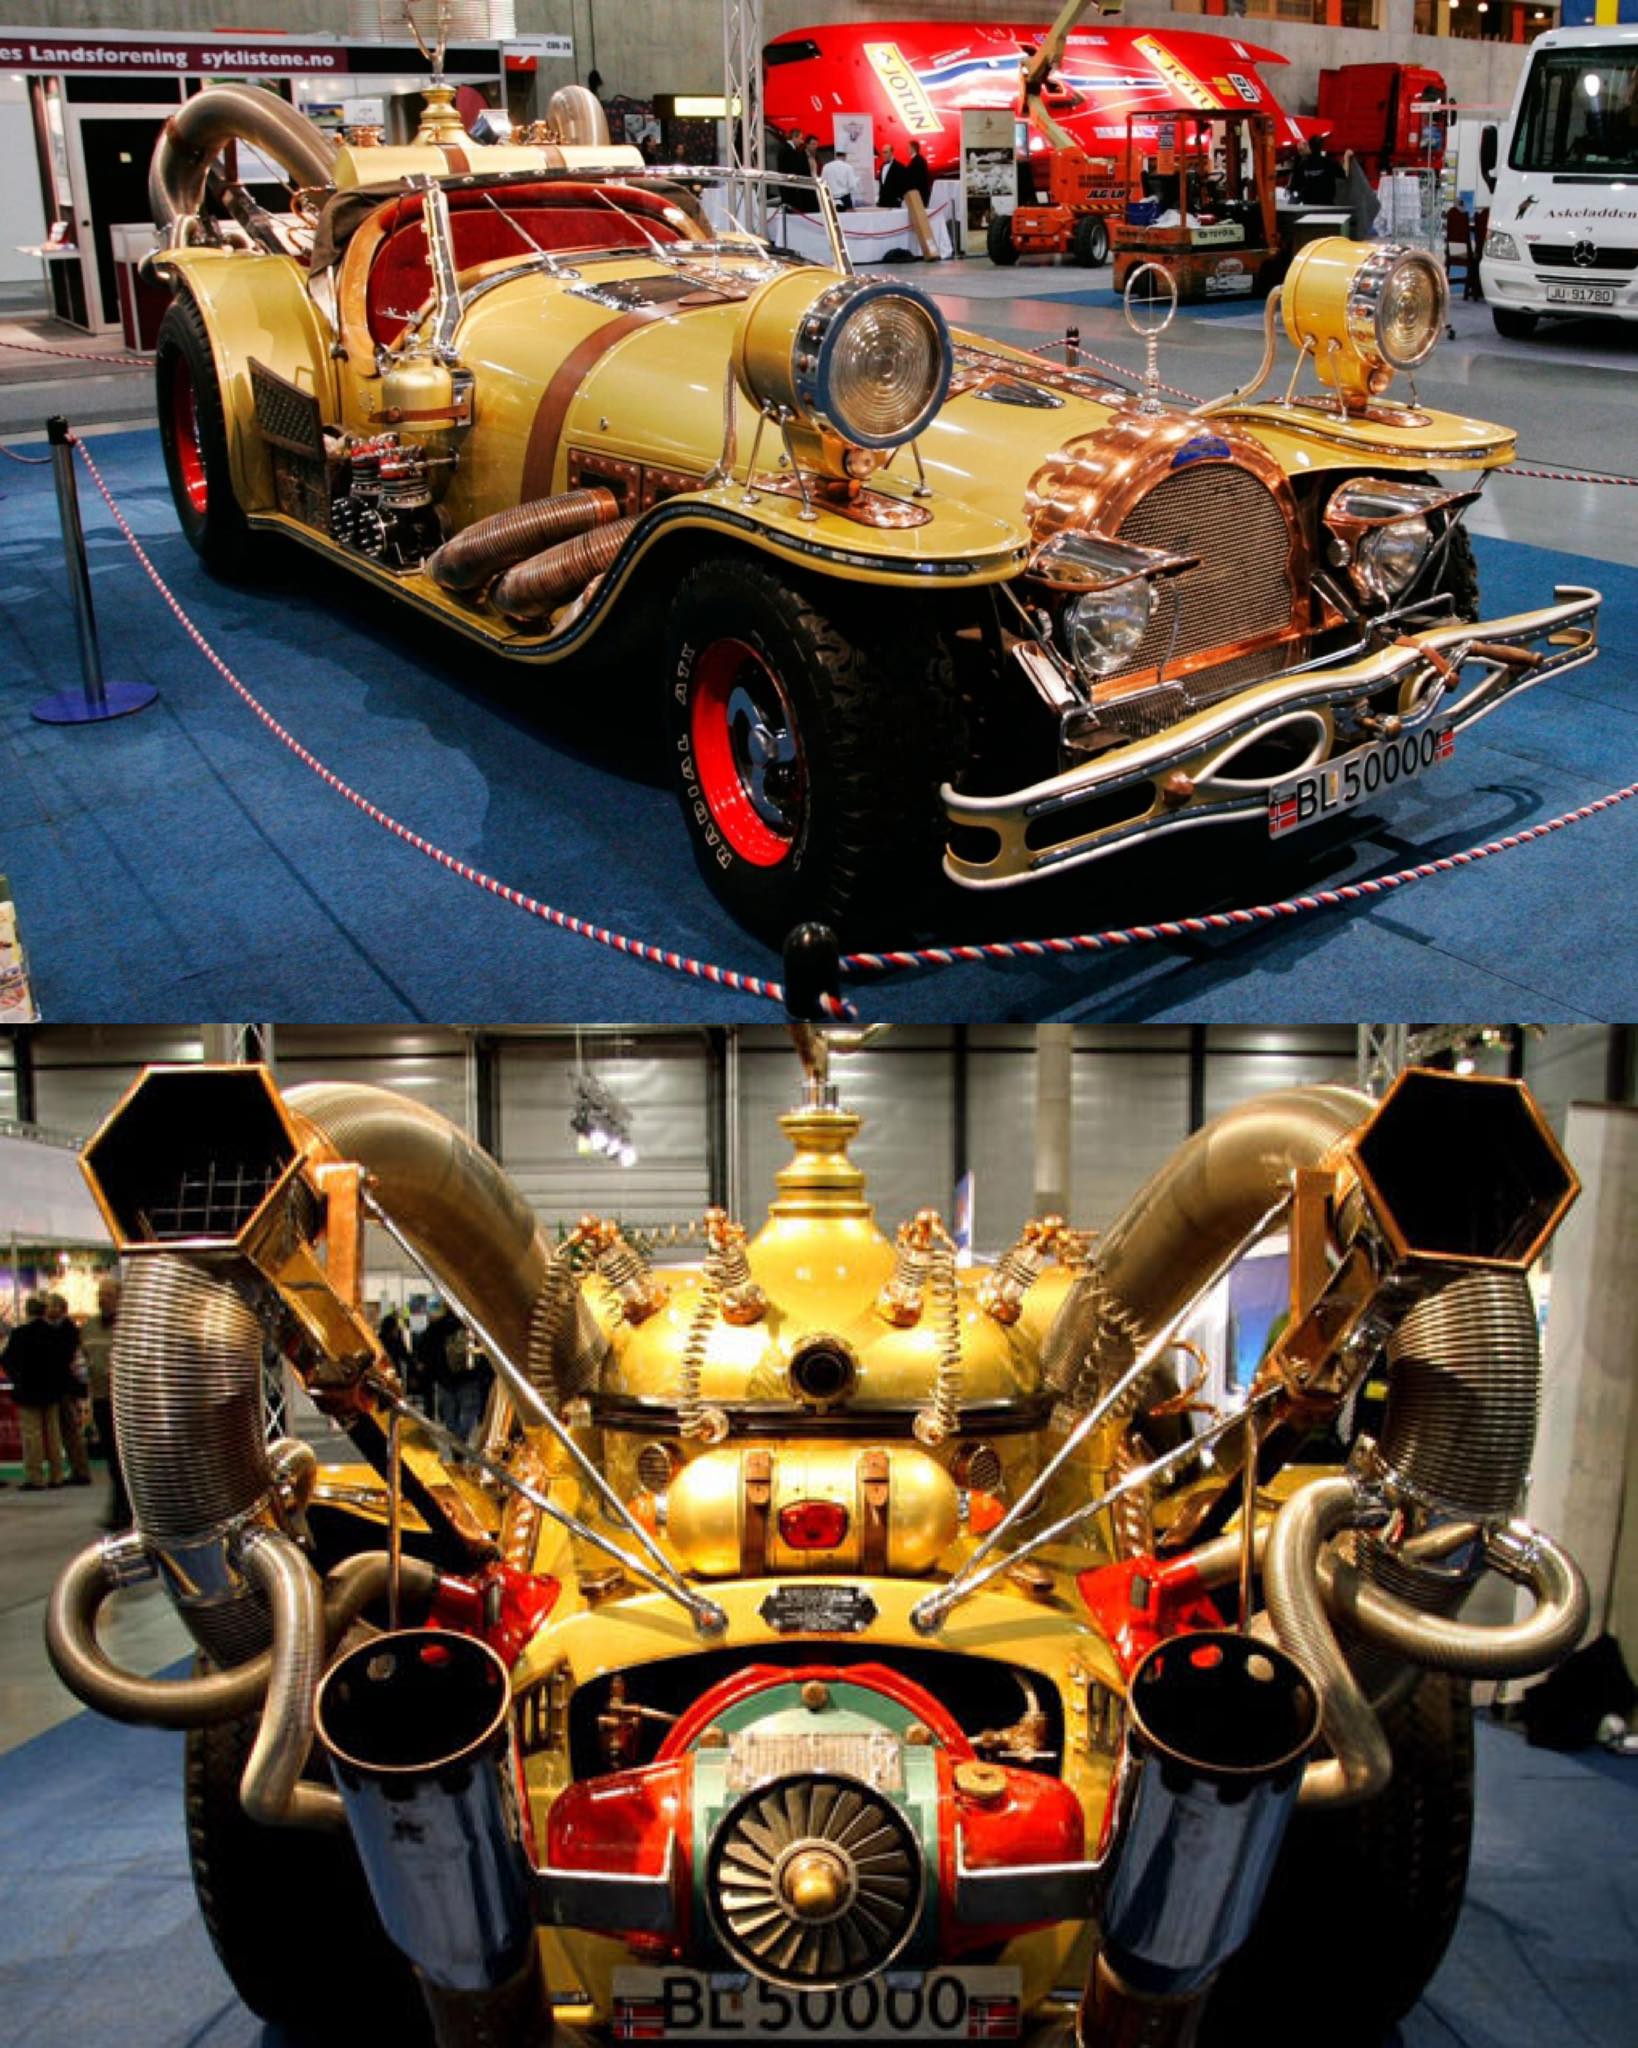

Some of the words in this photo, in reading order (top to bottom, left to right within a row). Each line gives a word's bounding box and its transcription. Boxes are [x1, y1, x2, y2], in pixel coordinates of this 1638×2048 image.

[29, 45, 188, 69] Landsforening
[202, 50, 335, 69] syklistene.no
[882, 66, 931, 130] JOTUN
[1163, 62, 1219, 110] JOTU
[1545, 207, 1638, 220] Askeladden
[1551, 288, 1566, 299] JU
[1571, 288, 1611, 302] 91780
[677, 732, 733, 869] RADIAL
